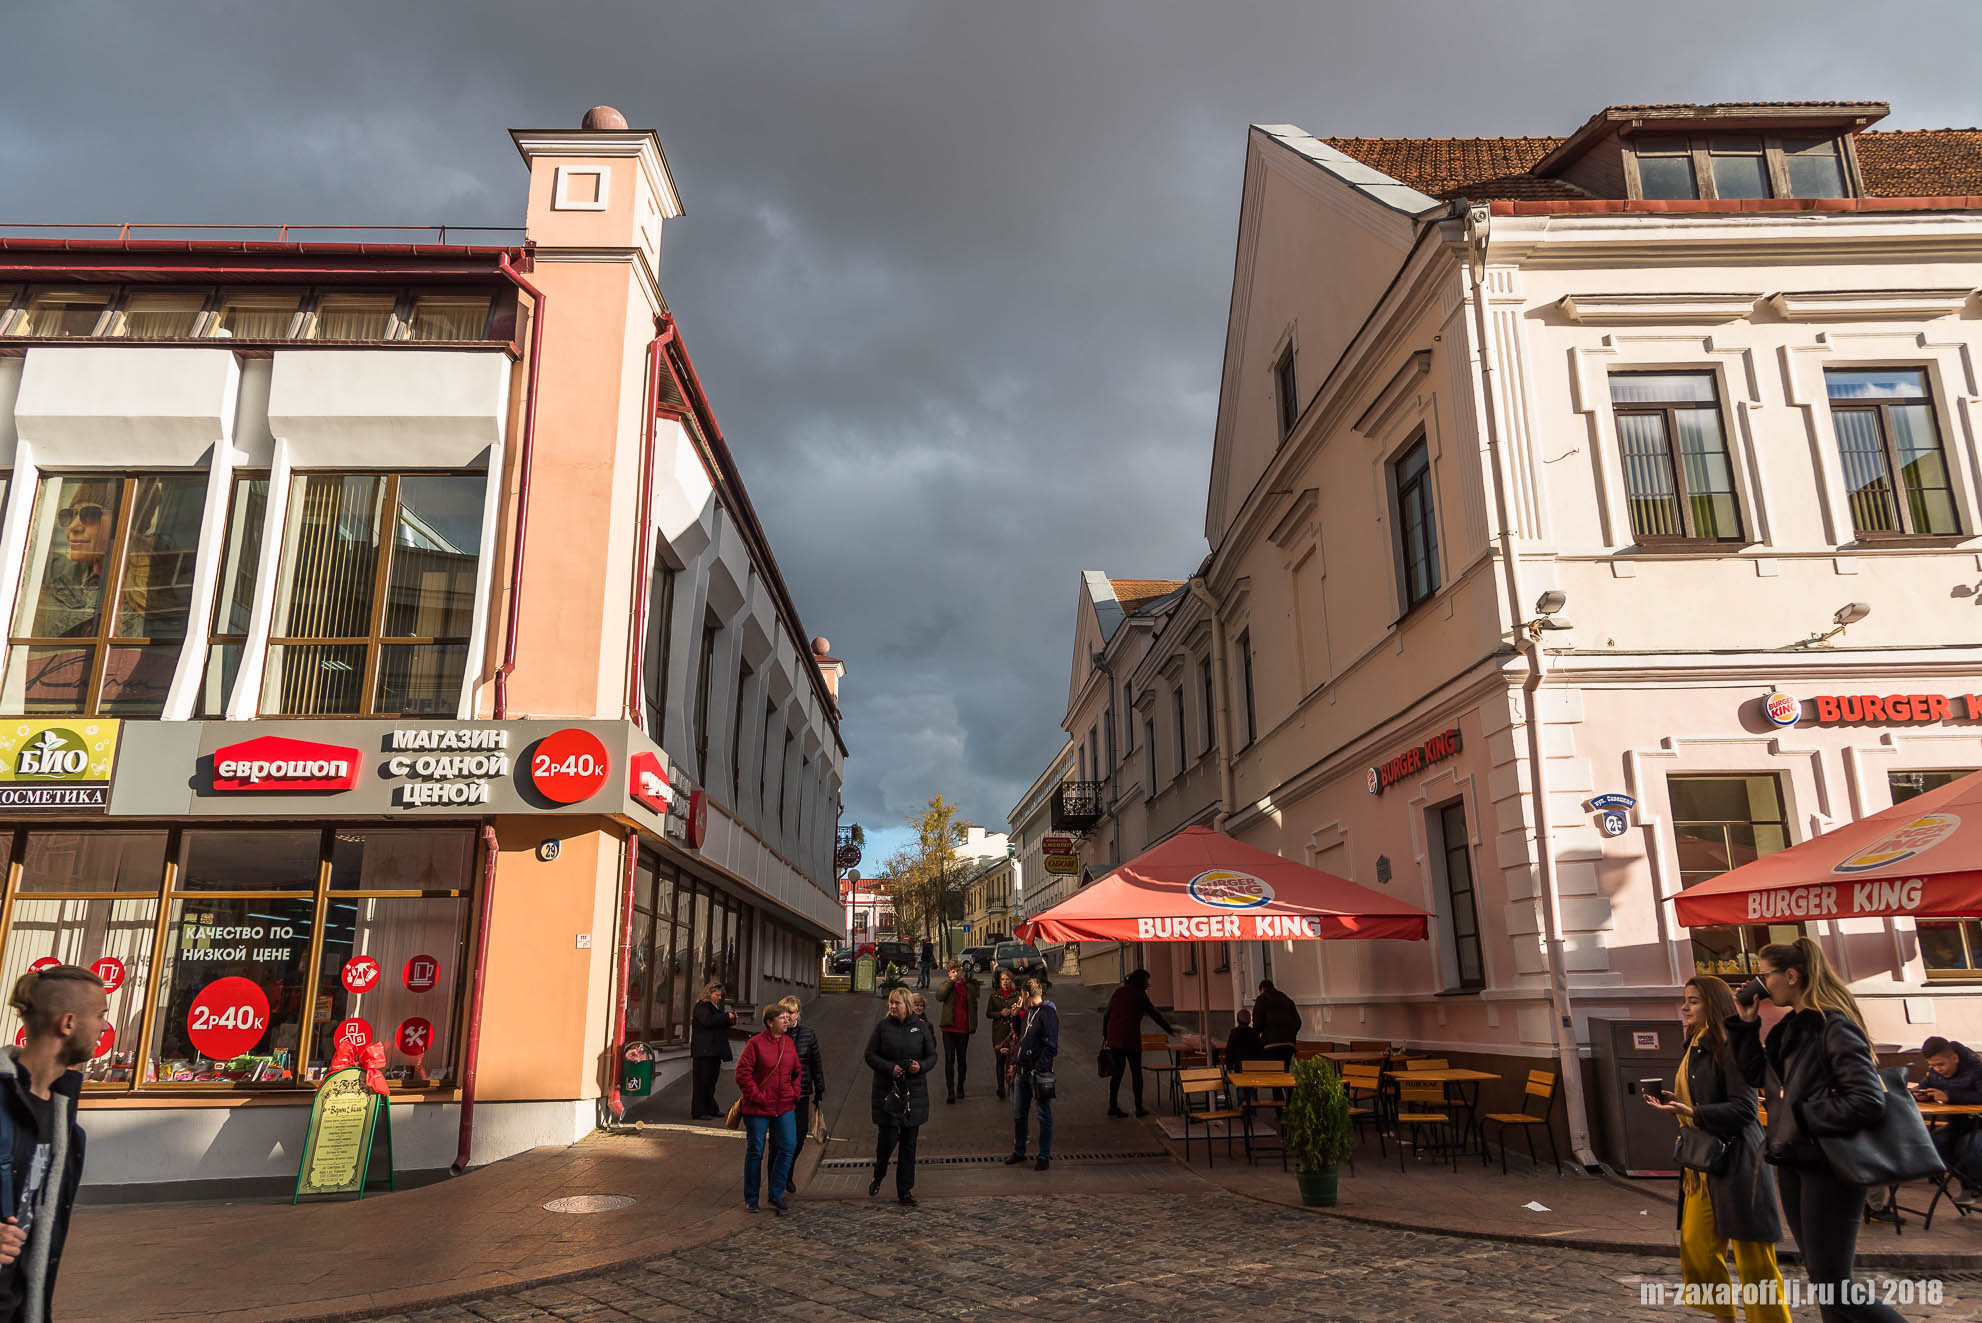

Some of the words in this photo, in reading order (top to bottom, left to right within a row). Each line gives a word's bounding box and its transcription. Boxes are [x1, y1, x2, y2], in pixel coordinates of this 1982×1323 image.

[1816, 694, 1953, 721] BURGER
[392, 729, 508, 750] МАГАЗИН
[18, 748, 89, 776] БИО
[388, 756, 411, 777] С
[415, 752, 508, 780] ОДНОЙ
[1381, 747, 1421, 786] BURGER
[1424, 729, 1455, 764] KING
[217, 757, 349, 783] еврошоп
[0, 789, 104, 804] ОСМЕТИКА
[402, 779, 489, 807] ЦЕНОЙ
[1608, 818, 1624, 832] 25
[545, 844, 557, 859] 29
[1747, 886, 1838, 919] BURGER
[1853, 879, 1923, 913] KING
[185, 926, 264, 939] КАЧЕСТВО
[269, 926, 294, 939] ПО
[1137, 915, 1241, 938] BURGER
[1255, 916, 1321, 937] KING
[182, 945, 247, 961] НИЗКОЙ
[252, 948, 291, 963] ЦЕНЕ
